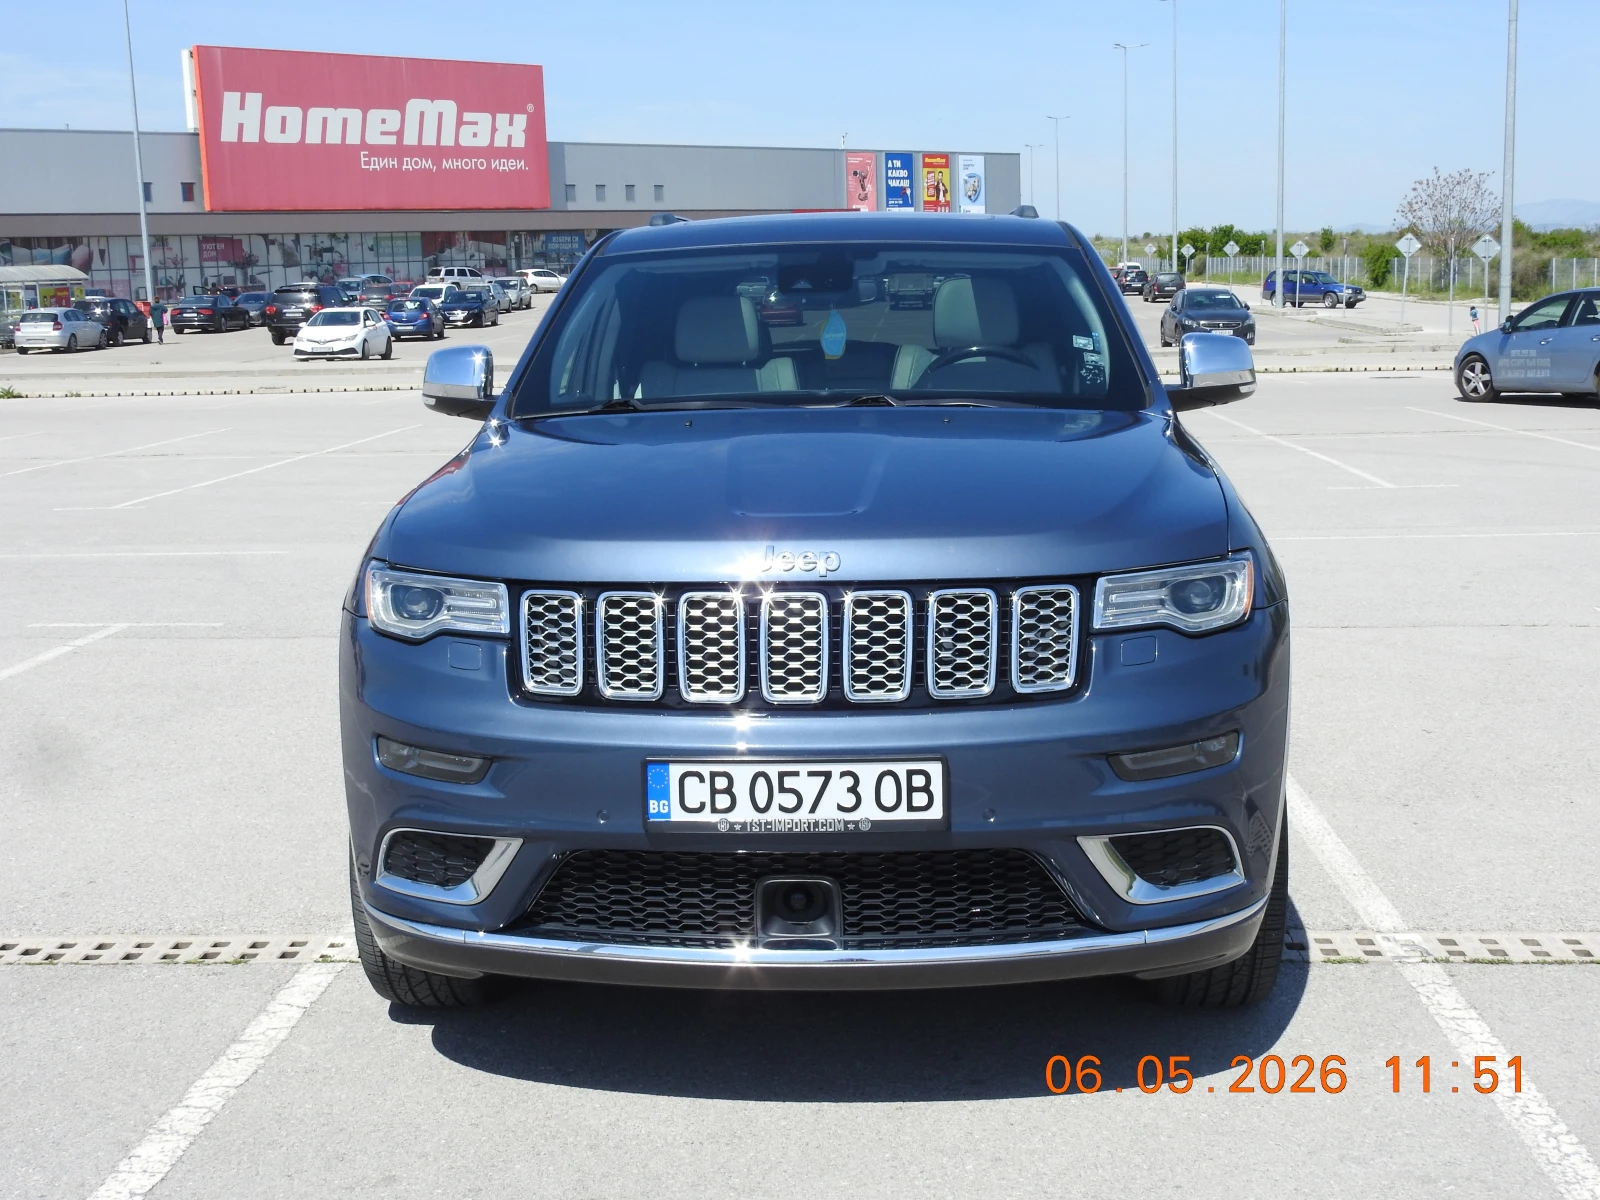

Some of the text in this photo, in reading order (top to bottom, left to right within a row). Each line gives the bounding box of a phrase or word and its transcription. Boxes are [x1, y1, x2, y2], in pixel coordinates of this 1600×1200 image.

[220, 91, 528, 148] HomeMax
[360, 151, 529, 172] Един дом, много идеи.
[887, 159, 901, 168] А ТИ
[887, 169, 909, 178] КАКВО
[887, 179, 910, 188] ЧАКАШ
[202, 242, 225, 250] УЮТЕН
[202, 250, 217, 259] ДОМ
[761, 544, 841, 577] Jeep
[678, 770, 737, 814] CB
[749, 770, 862, 814] 0573
[649, 799, 669, 814] BG
[745, 818, 845, 832] TST-IMPORT.COM
